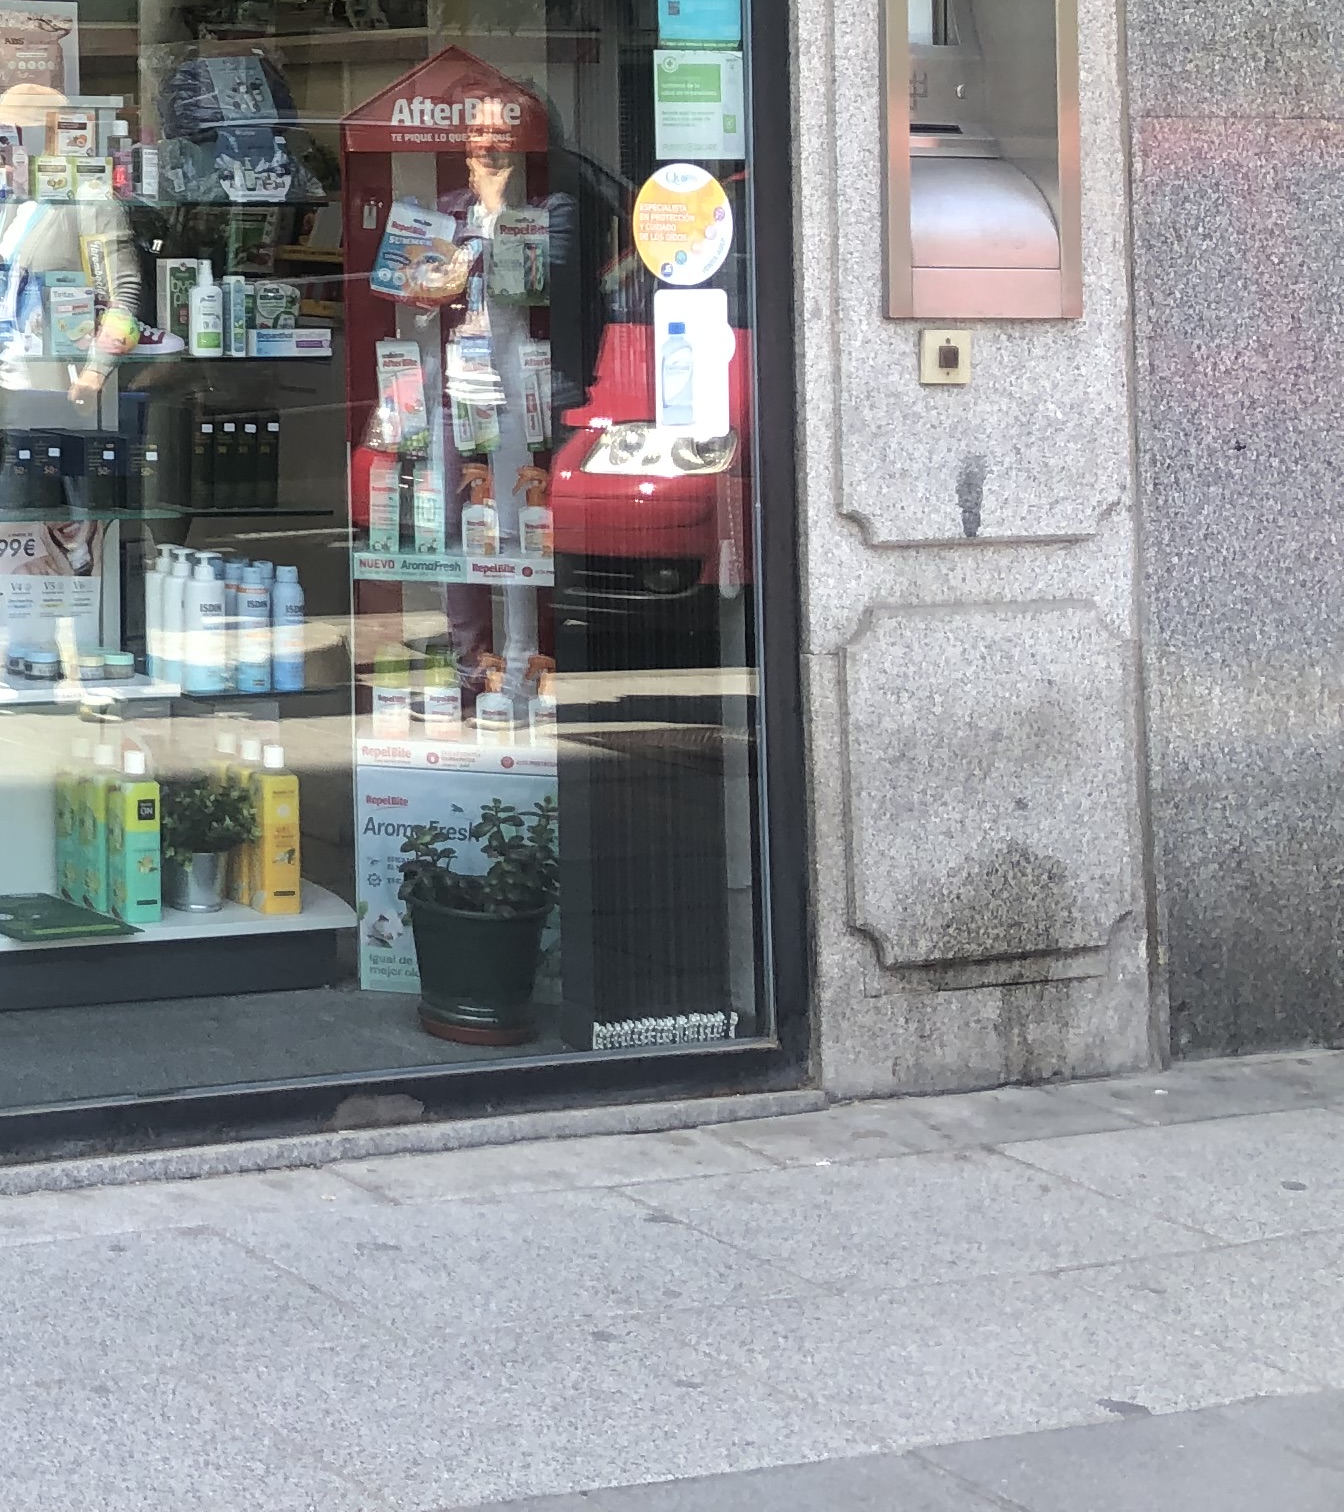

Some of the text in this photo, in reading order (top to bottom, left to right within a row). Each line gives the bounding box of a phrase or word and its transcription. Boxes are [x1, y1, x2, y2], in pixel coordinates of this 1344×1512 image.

[390, 96, 522, 126] AfterBite
[391, 133, 403, 142] TE
[404, 133, 434, 143] PIQUE
[434, 133, 447, 142] LO
[639, 203, 688, 212] ESPECIALISTA
[645, 223, 677, 231] CUIDADO
[359, 558, 516, 575] NUEVO AromaFresh RepelBite
[199, 603, 223, 614] ISDIN
[361, 745, 412, 759] RepelBite
[365, 794, 409, 807] RepelBite
[369, 953, 413, 966] Igual de
[369, 966, 402, 978] mejor
